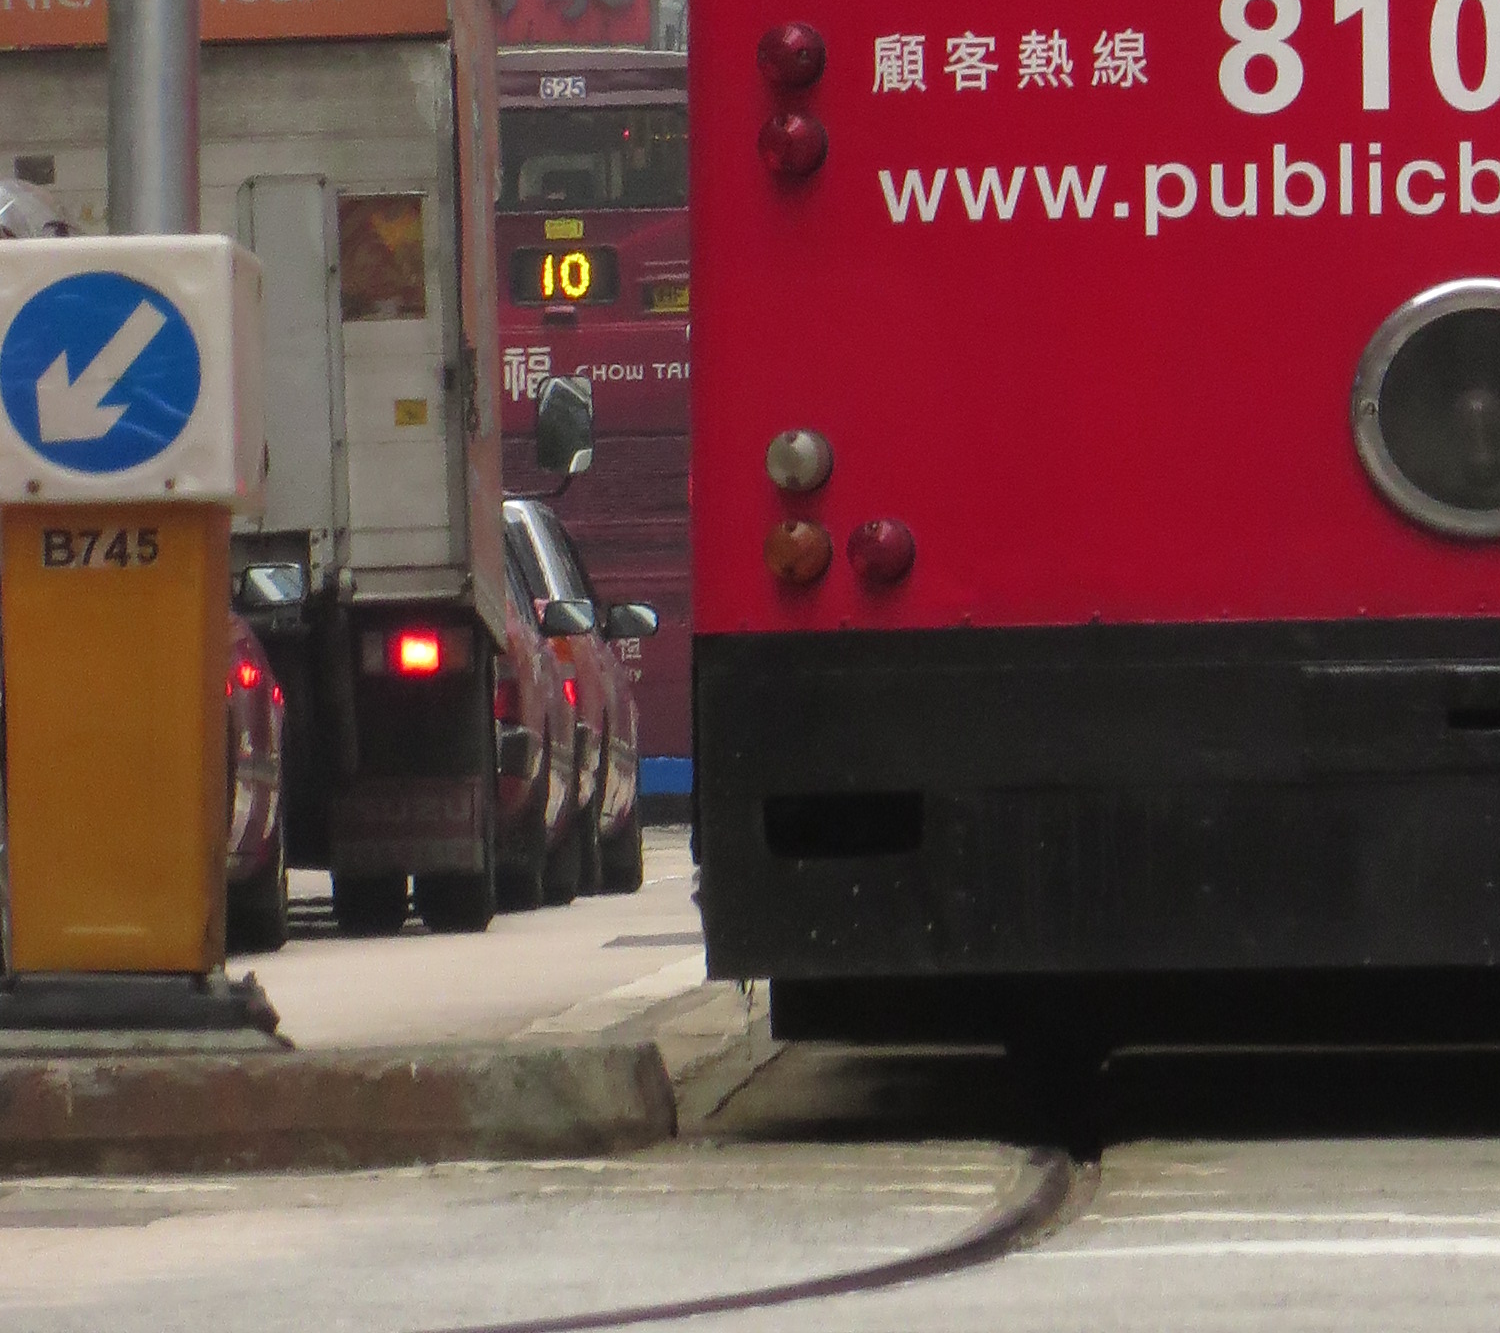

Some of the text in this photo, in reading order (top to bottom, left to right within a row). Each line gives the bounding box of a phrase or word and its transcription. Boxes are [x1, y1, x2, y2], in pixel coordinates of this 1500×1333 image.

[871, 27, 1149, 94] 顧客熱線
[541, 77, 586, 100] 625
[541, 250, 591, 300] 10
[42, 527, 160, 569] B745
